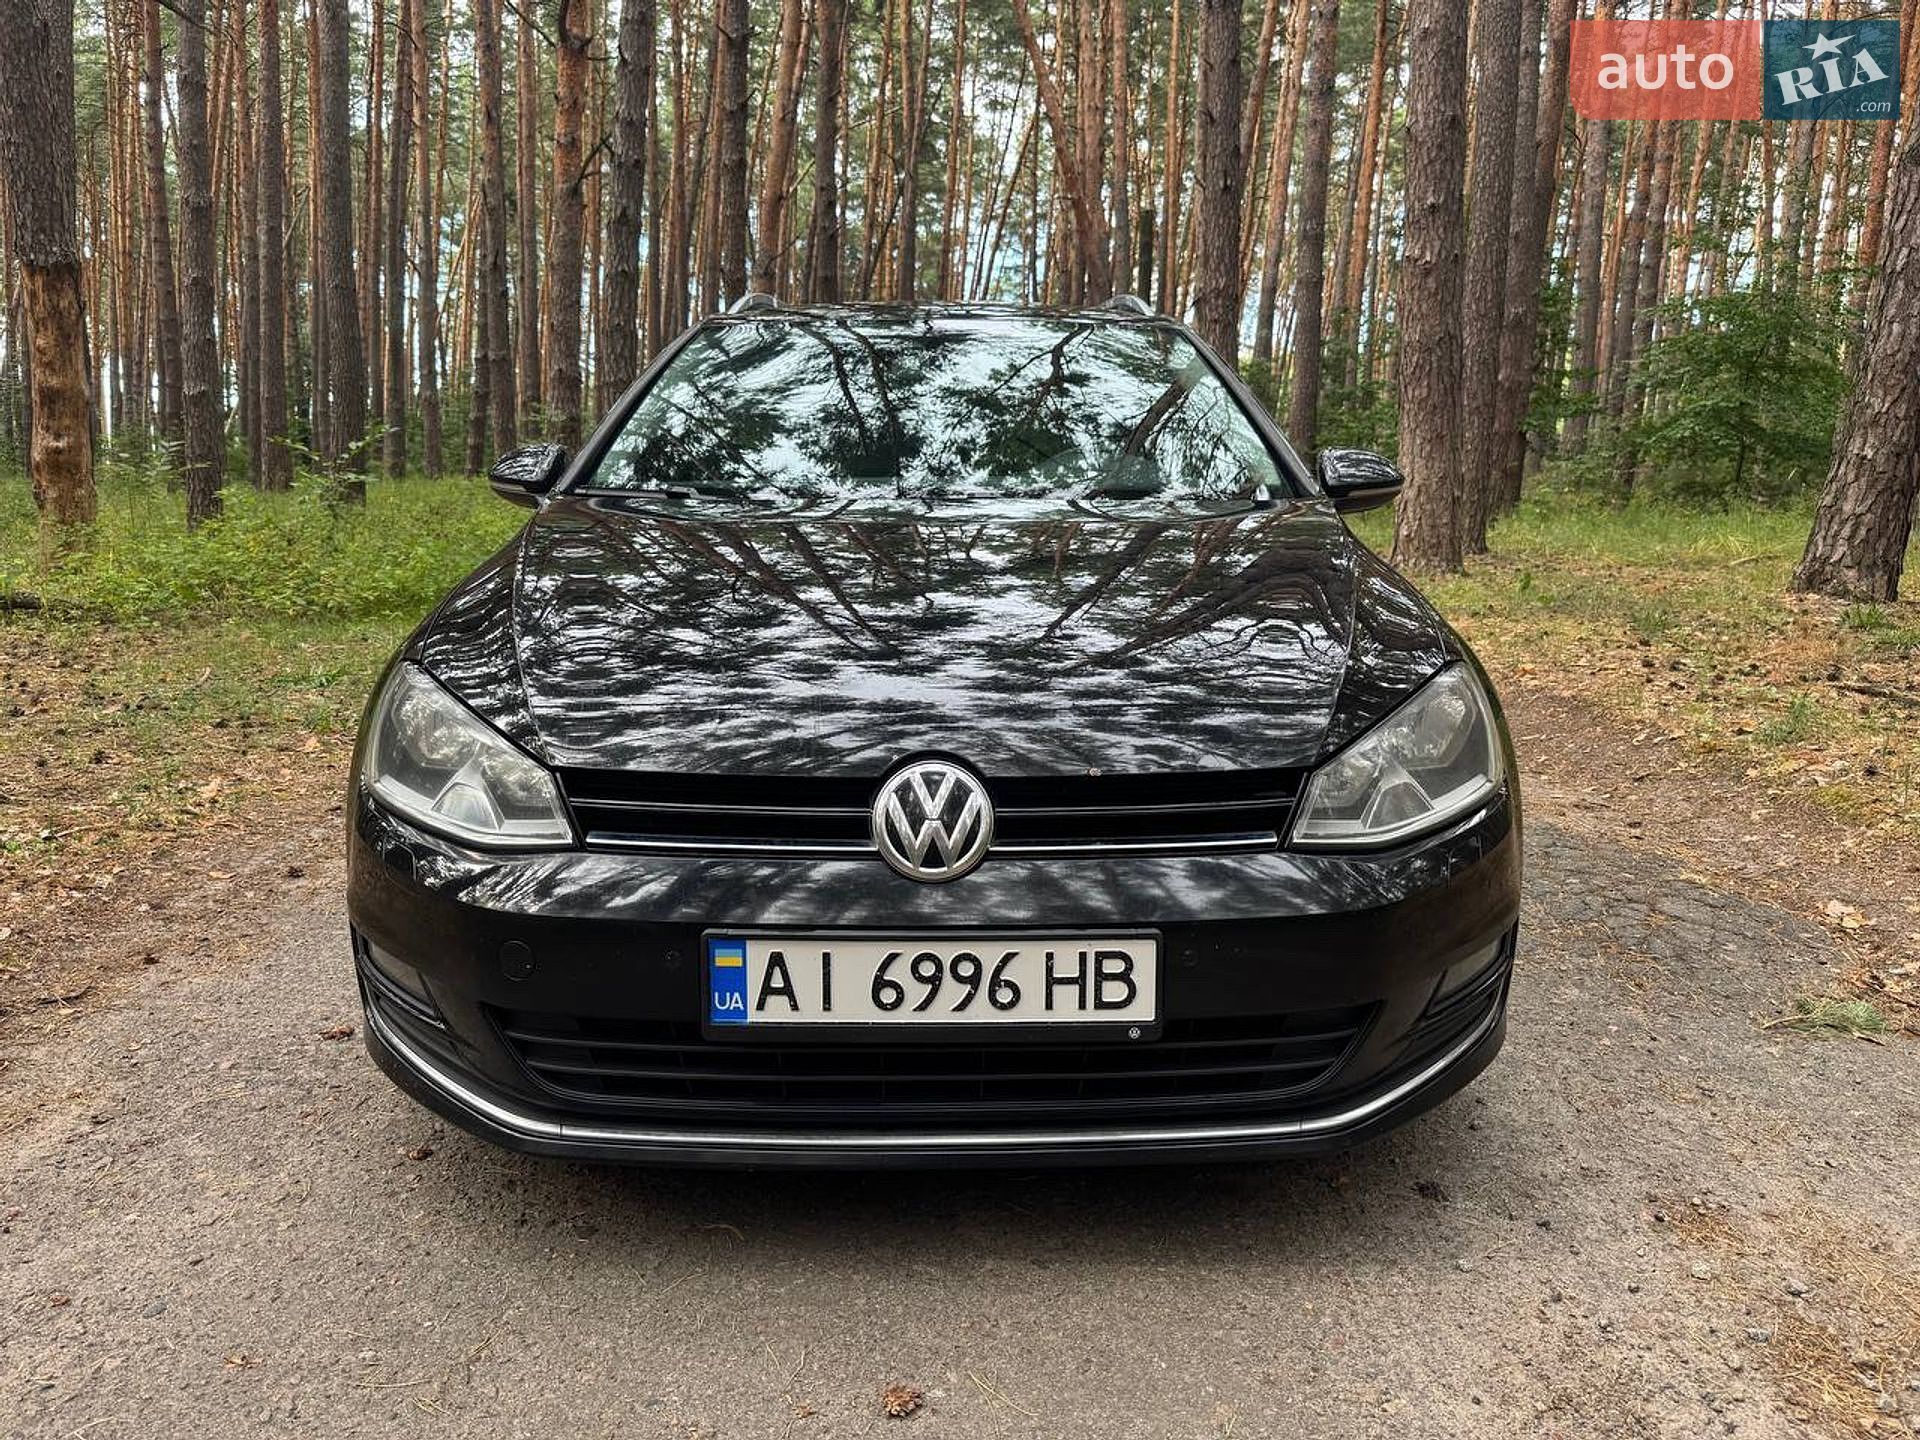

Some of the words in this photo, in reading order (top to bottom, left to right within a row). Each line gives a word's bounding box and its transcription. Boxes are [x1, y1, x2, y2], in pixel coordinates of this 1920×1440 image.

[714, 991, 745, 1011] UA
[870, 950, 1022, 1012] 6996
[1044, 950, 1138, 1011] HB
